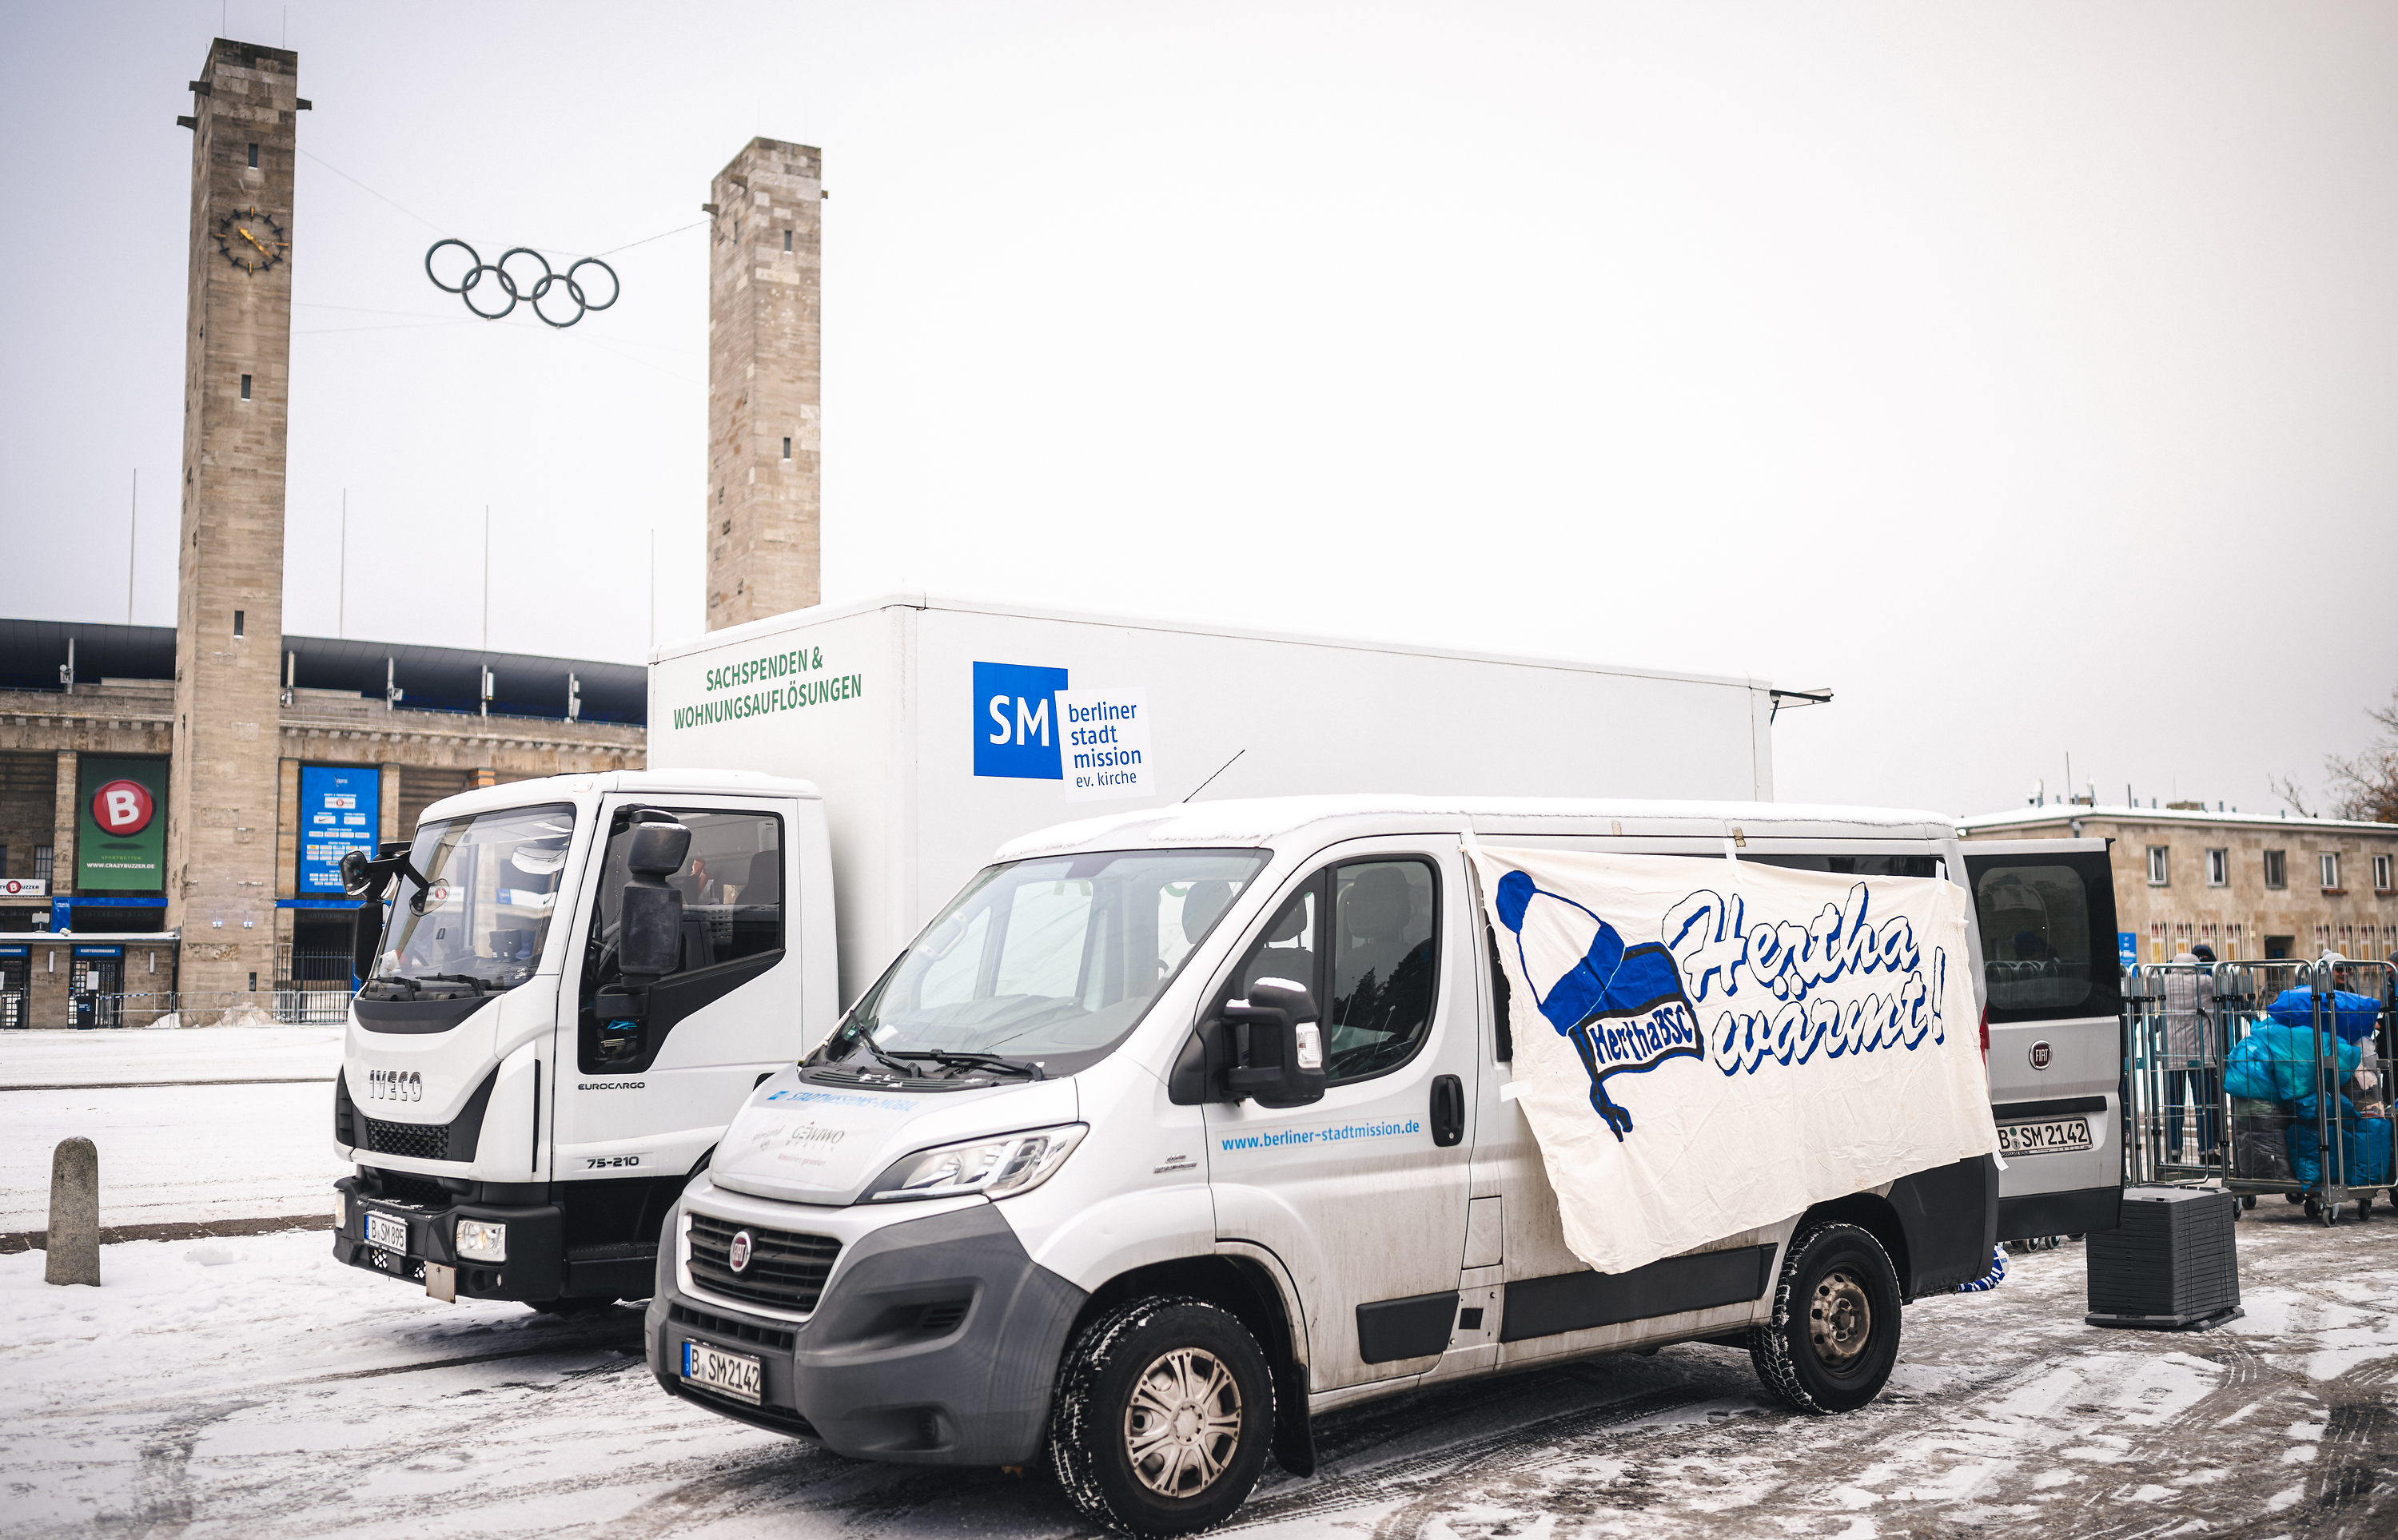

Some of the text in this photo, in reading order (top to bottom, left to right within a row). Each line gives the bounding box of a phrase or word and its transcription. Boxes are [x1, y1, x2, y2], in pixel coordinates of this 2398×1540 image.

[706, 646, 823, 691] SACHSPENDEN &
[674, 679, 862, 730] WOHNUNGSAUFLÖSUNGEN
[1069, 701, 1137, 722] berliner
[989, 694, 1050, 746] SM
[1071, 725, 1118, 746] stadt
[1074, 746, 1141, 768] mission
[1076, 770, 1137, 787] ev. kirche
[106, 790, 141, 826] B
[1662, 881, 1920, 1003] Hertha
[1711, 946, 1946, 1076] wärmt!
[2035, 1049, 2049, 1062] FIAT
[369, 1069, 423, 1102] IVECO
[577, 1081, 645, 1091] EUROCARGO
[787, 1092, 919, 1112] STADTMISSIONS-MOBIL
[791, 1124, 845, 1144] GEWIWO
[1221, 1120, 1420, 1151] www.berliner-stadtmission.de
[1998, 1123, 2088, 1149] B SM 2142
[587, 1156, 639, 1169] 75-210
[372, 1220, 404, 1248] B SM 895
[732, 1243, 746, 1262] FIAT
[691, 1348, 699, 1375] B
[708, 1353, 727, 1384] SM
[727, 1359, 760, 1395] 2142
